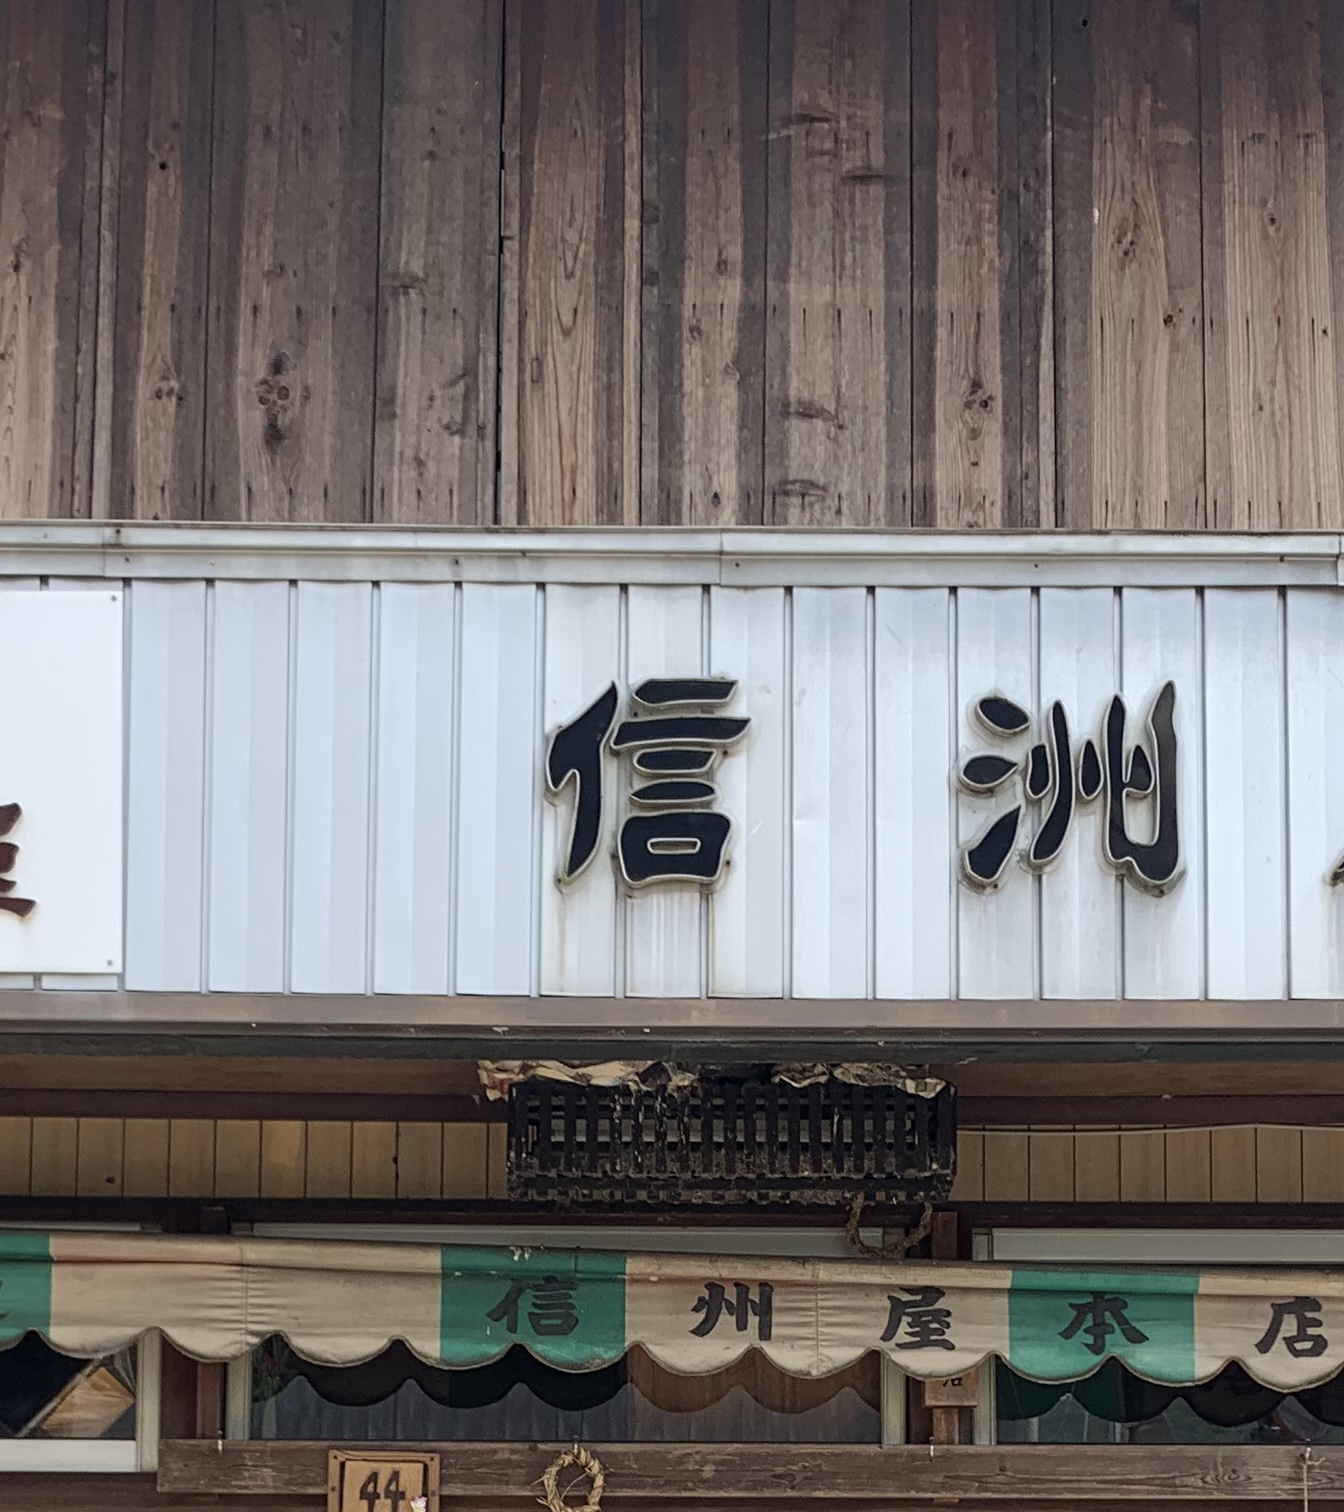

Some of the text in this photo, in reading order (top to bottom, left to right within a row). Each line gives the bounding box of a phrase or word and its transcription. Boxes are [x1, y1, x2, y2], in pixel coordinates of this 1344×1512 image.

[485, 1274, 1330, 1362] 信州屋本店
